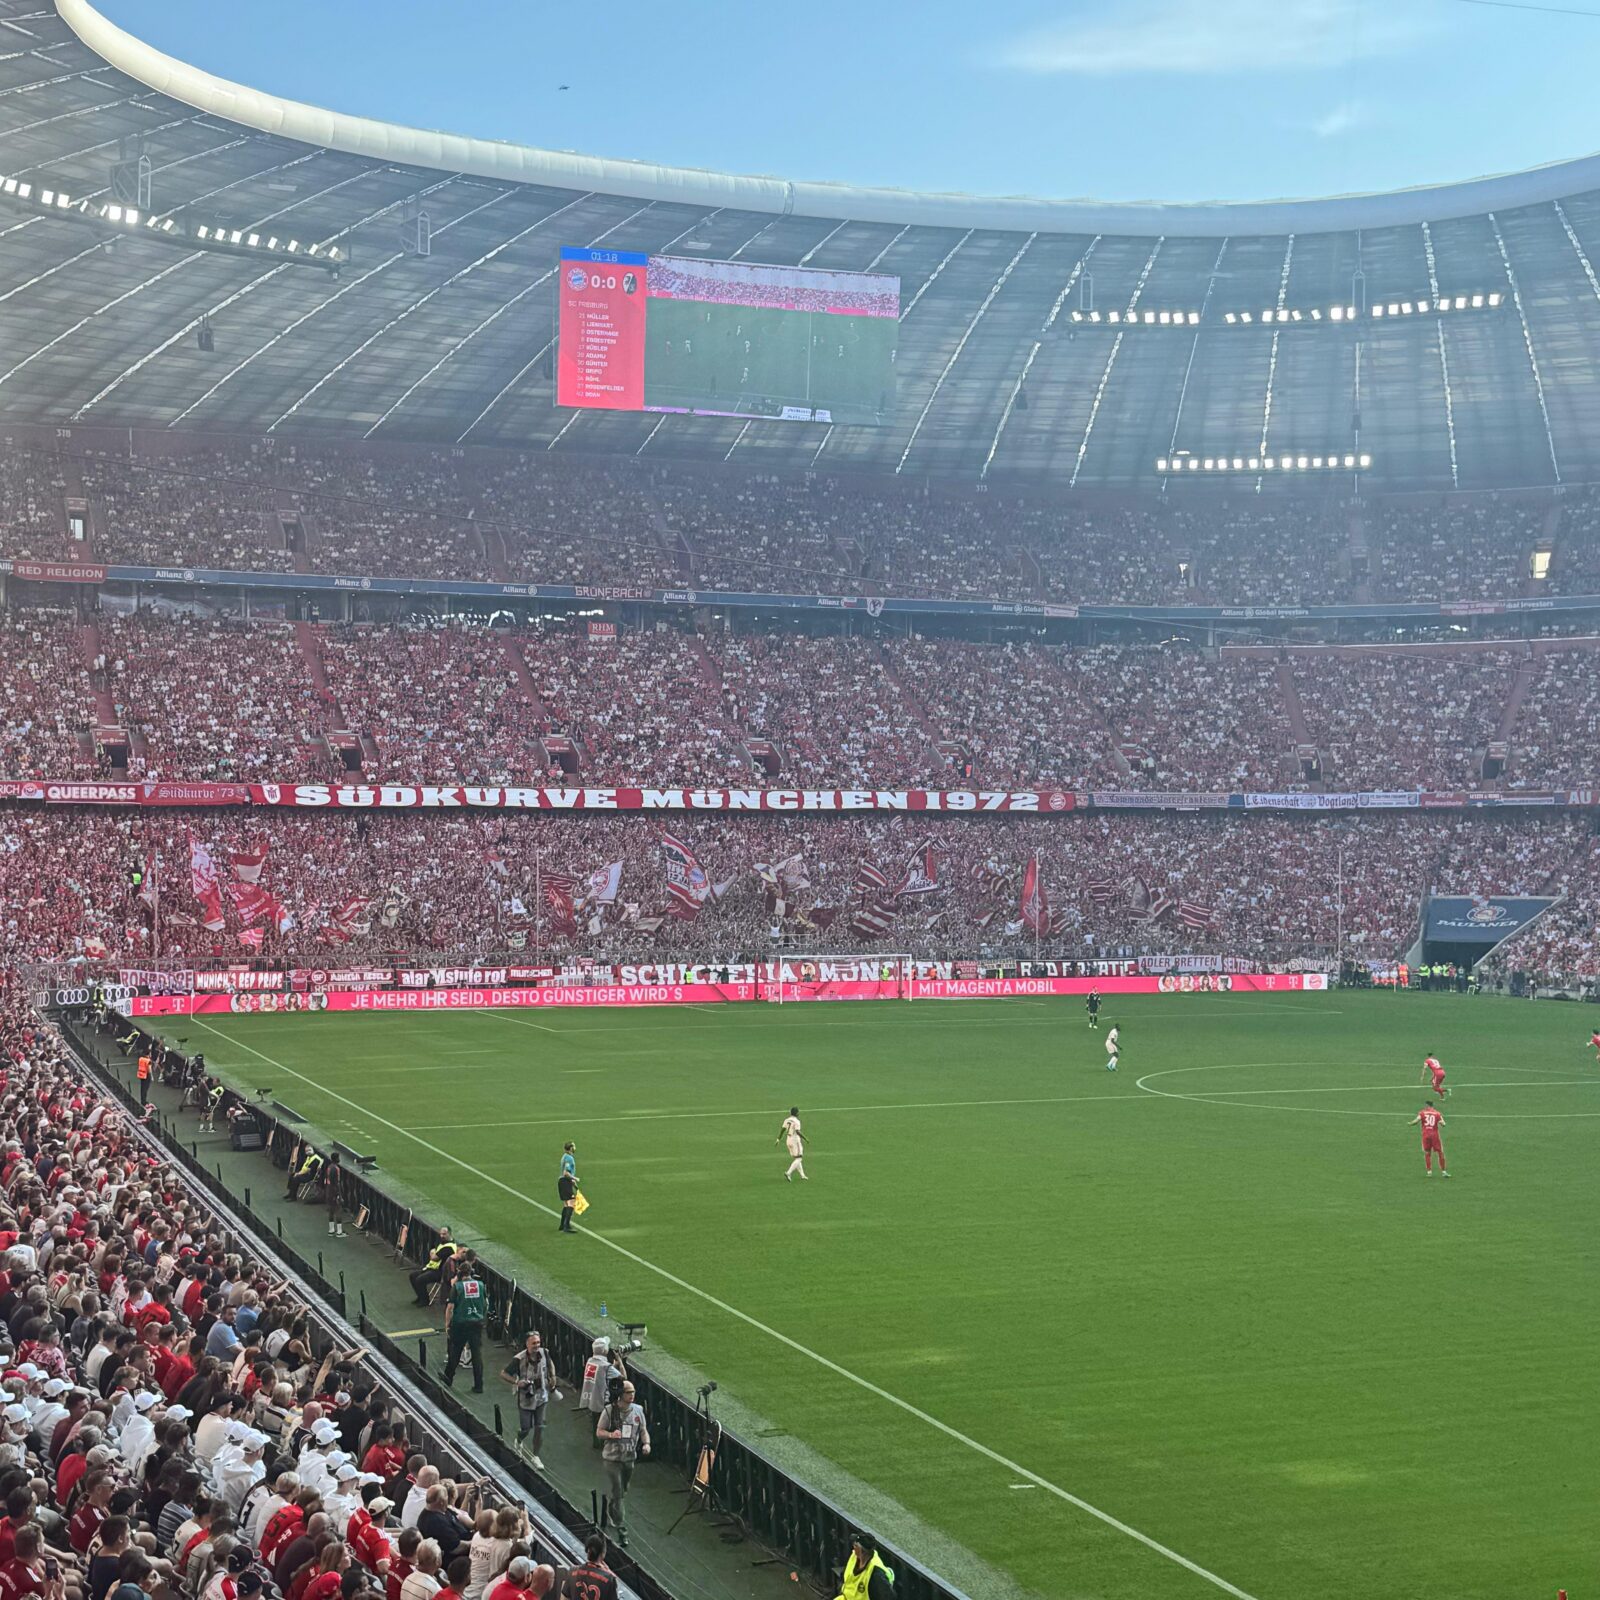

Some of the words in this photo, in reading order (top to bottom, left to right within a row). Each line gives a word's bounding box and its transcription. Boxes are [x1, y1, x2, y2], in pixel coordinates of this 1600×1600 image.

[591, 275, 616, 289] 0:0
[18, 565, 42, 575] RED
[47, 567, 103, 579] RELIGION
[155, 570, 183, 579] Allianz
[334, 579, 361, 587] Allianz
[502, 585, 528, 594] Allianz
[663, 592, 687, 600] Allianz
[817, 598, 840, 606] Allianz
[48, 785, 136, 800] QUEERPASS
[158, 786, 215, 800] Südkurve
[295, 785, 617, 808] SÜDKURVE
[641, 788, 909, 810] MÜNCHEN
[926, 791, 1039, 810] 1972
[1436, 919, 1519, 928] PAULANER
[1140, 957, 1170, 968] ADLER
[1174, 956, 1218, 968] BRETTEN
[919, 981, 944, 995] MIT
[946, 980, 1017, 995] MAGENTA
[1020, 979, 1056, 993] MOBIL
[351, 993, 369, 1008] JE
[373, 992, 418, 1007] MEHR
[421, 992, 448, 1006] IHR
[451, 991, 488, 1007] SEID,
[491, 990, 540, 1005] DESTO
[543, 987, 626, 1003] GÜNSTIGER
[1424, 1114, 1435, 1126] 30
